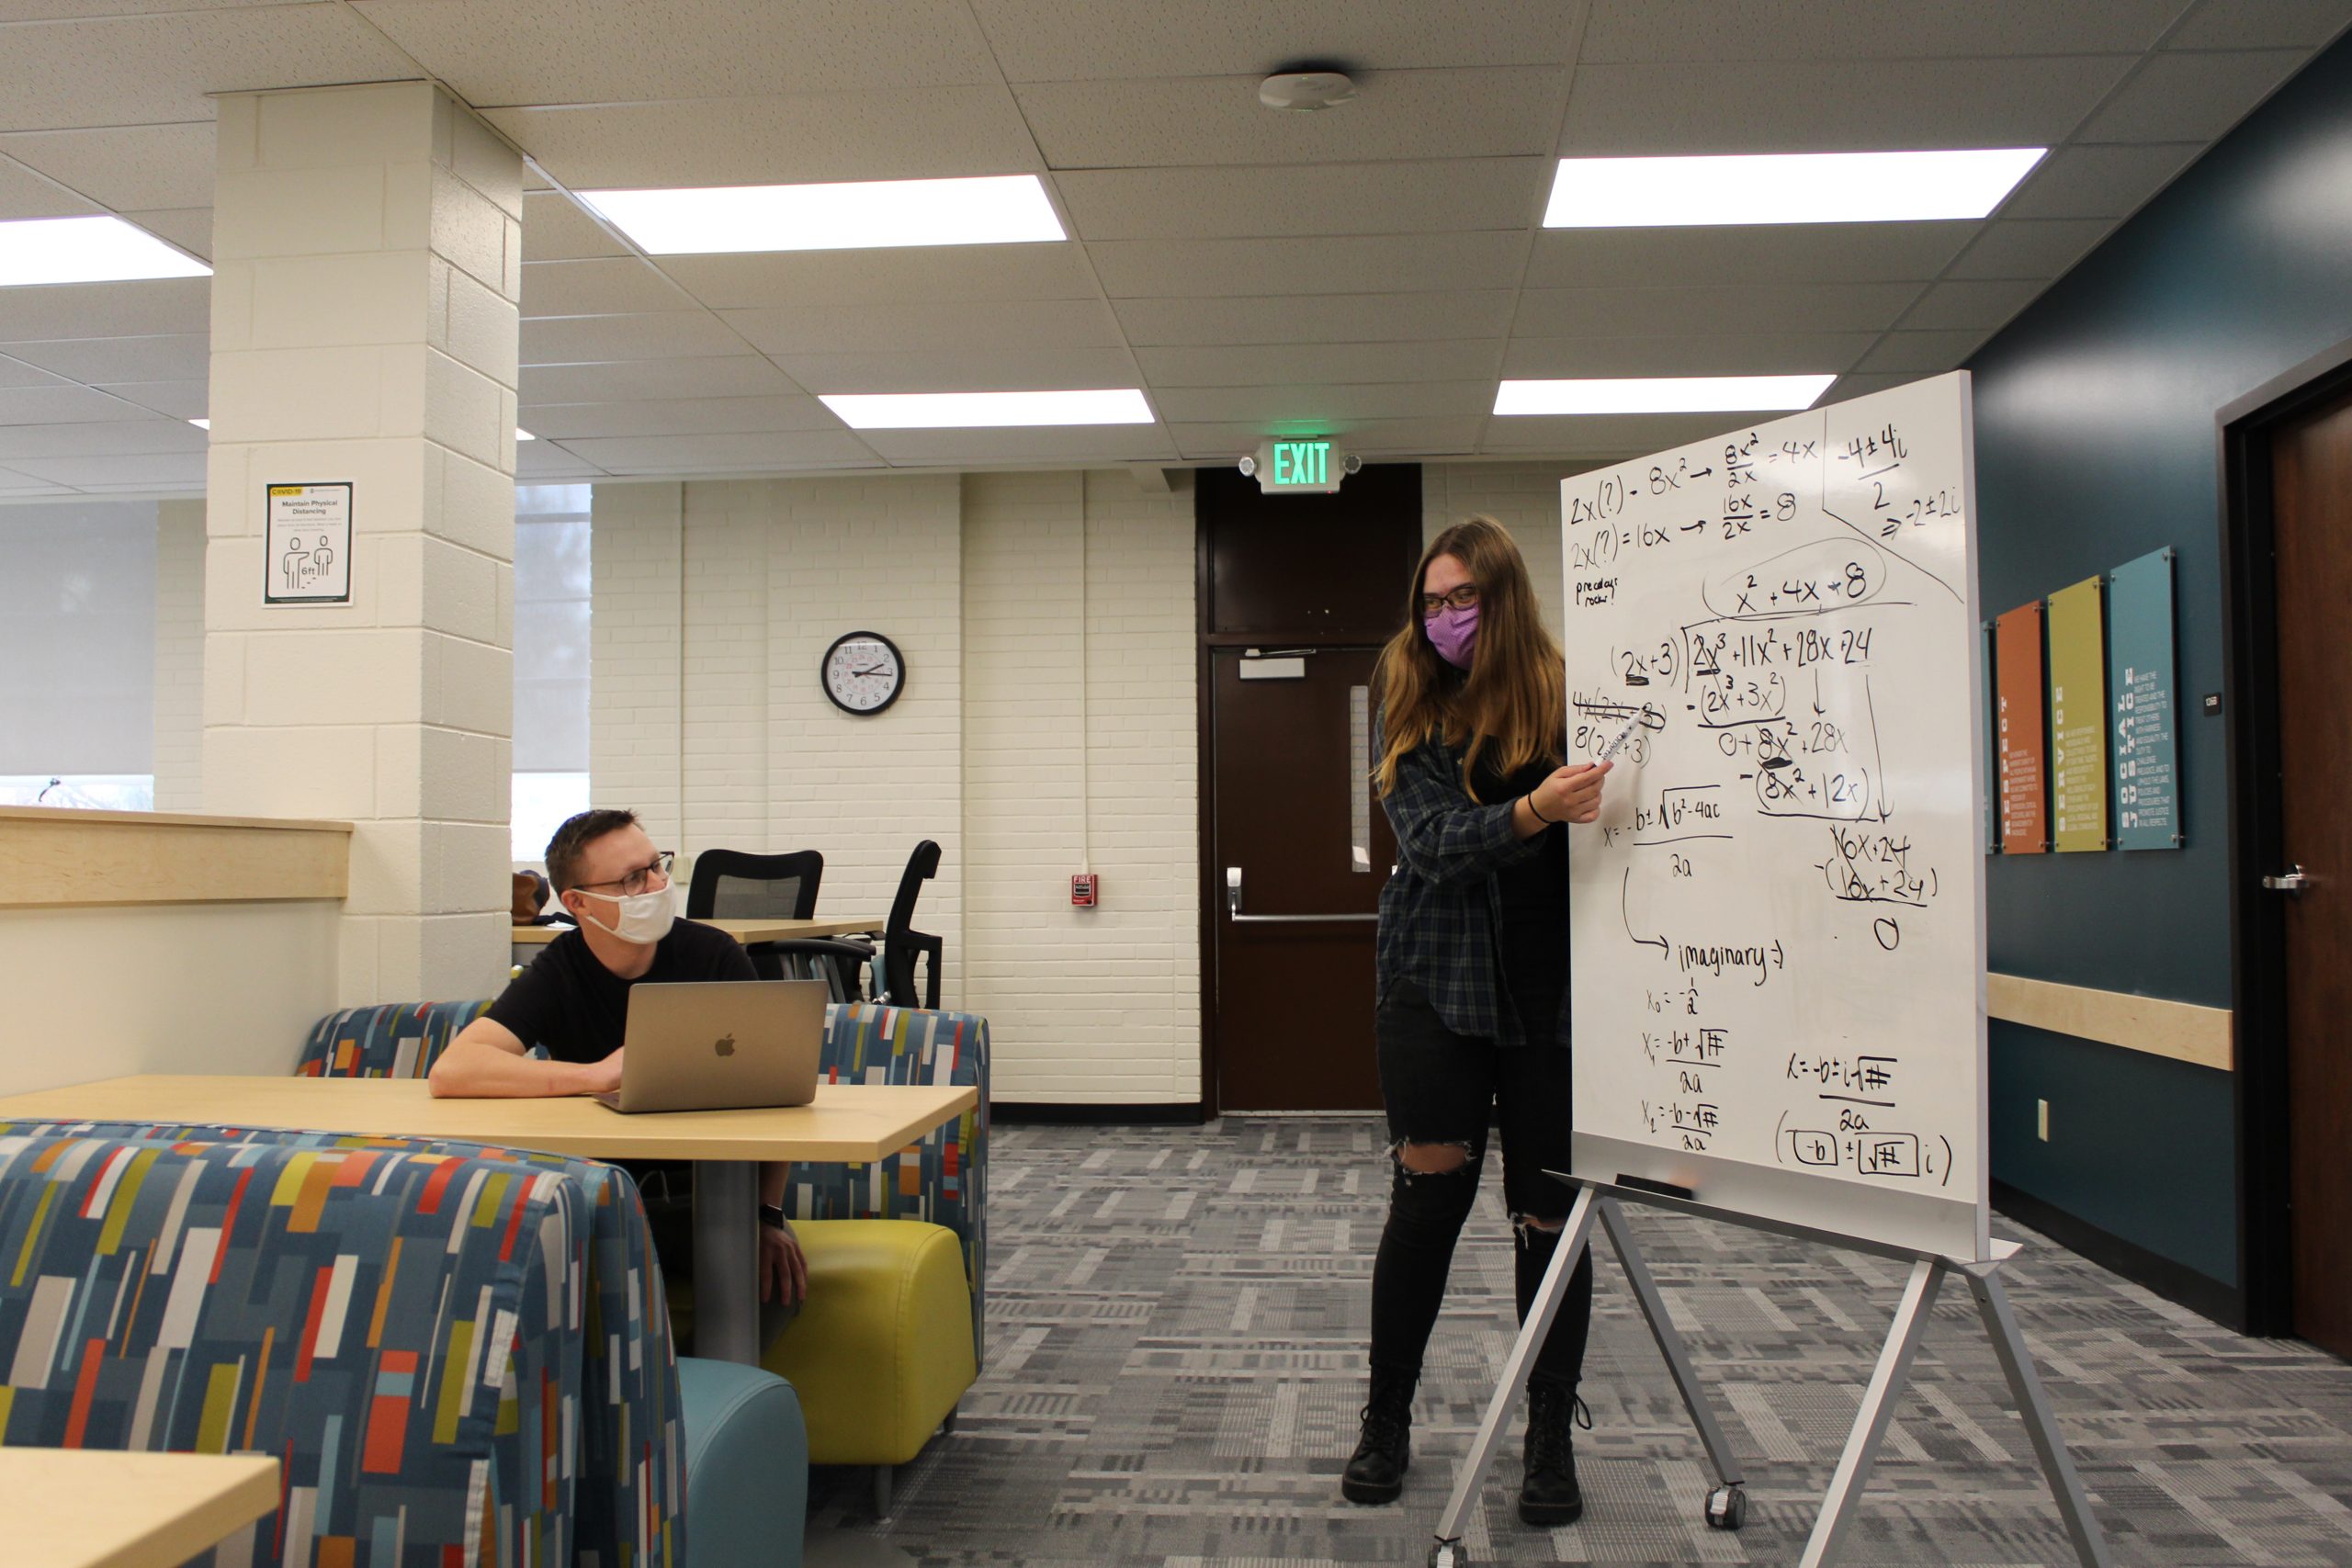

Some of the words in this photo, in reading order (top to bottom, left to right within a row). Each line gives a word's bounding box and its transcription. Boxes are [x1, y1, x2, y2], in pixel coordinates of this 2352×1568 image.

[1274, 443, 1330, 484] EXIT
[301, 567, 315, 575] 6ft
[2056, 687, 2065, 831] SERVICE
[2118, 694, 2130, 828] SOCIAL
[2125, 667, 2138, 828] JUSTICE
[1679, 944, 1767, 987] imaginary
